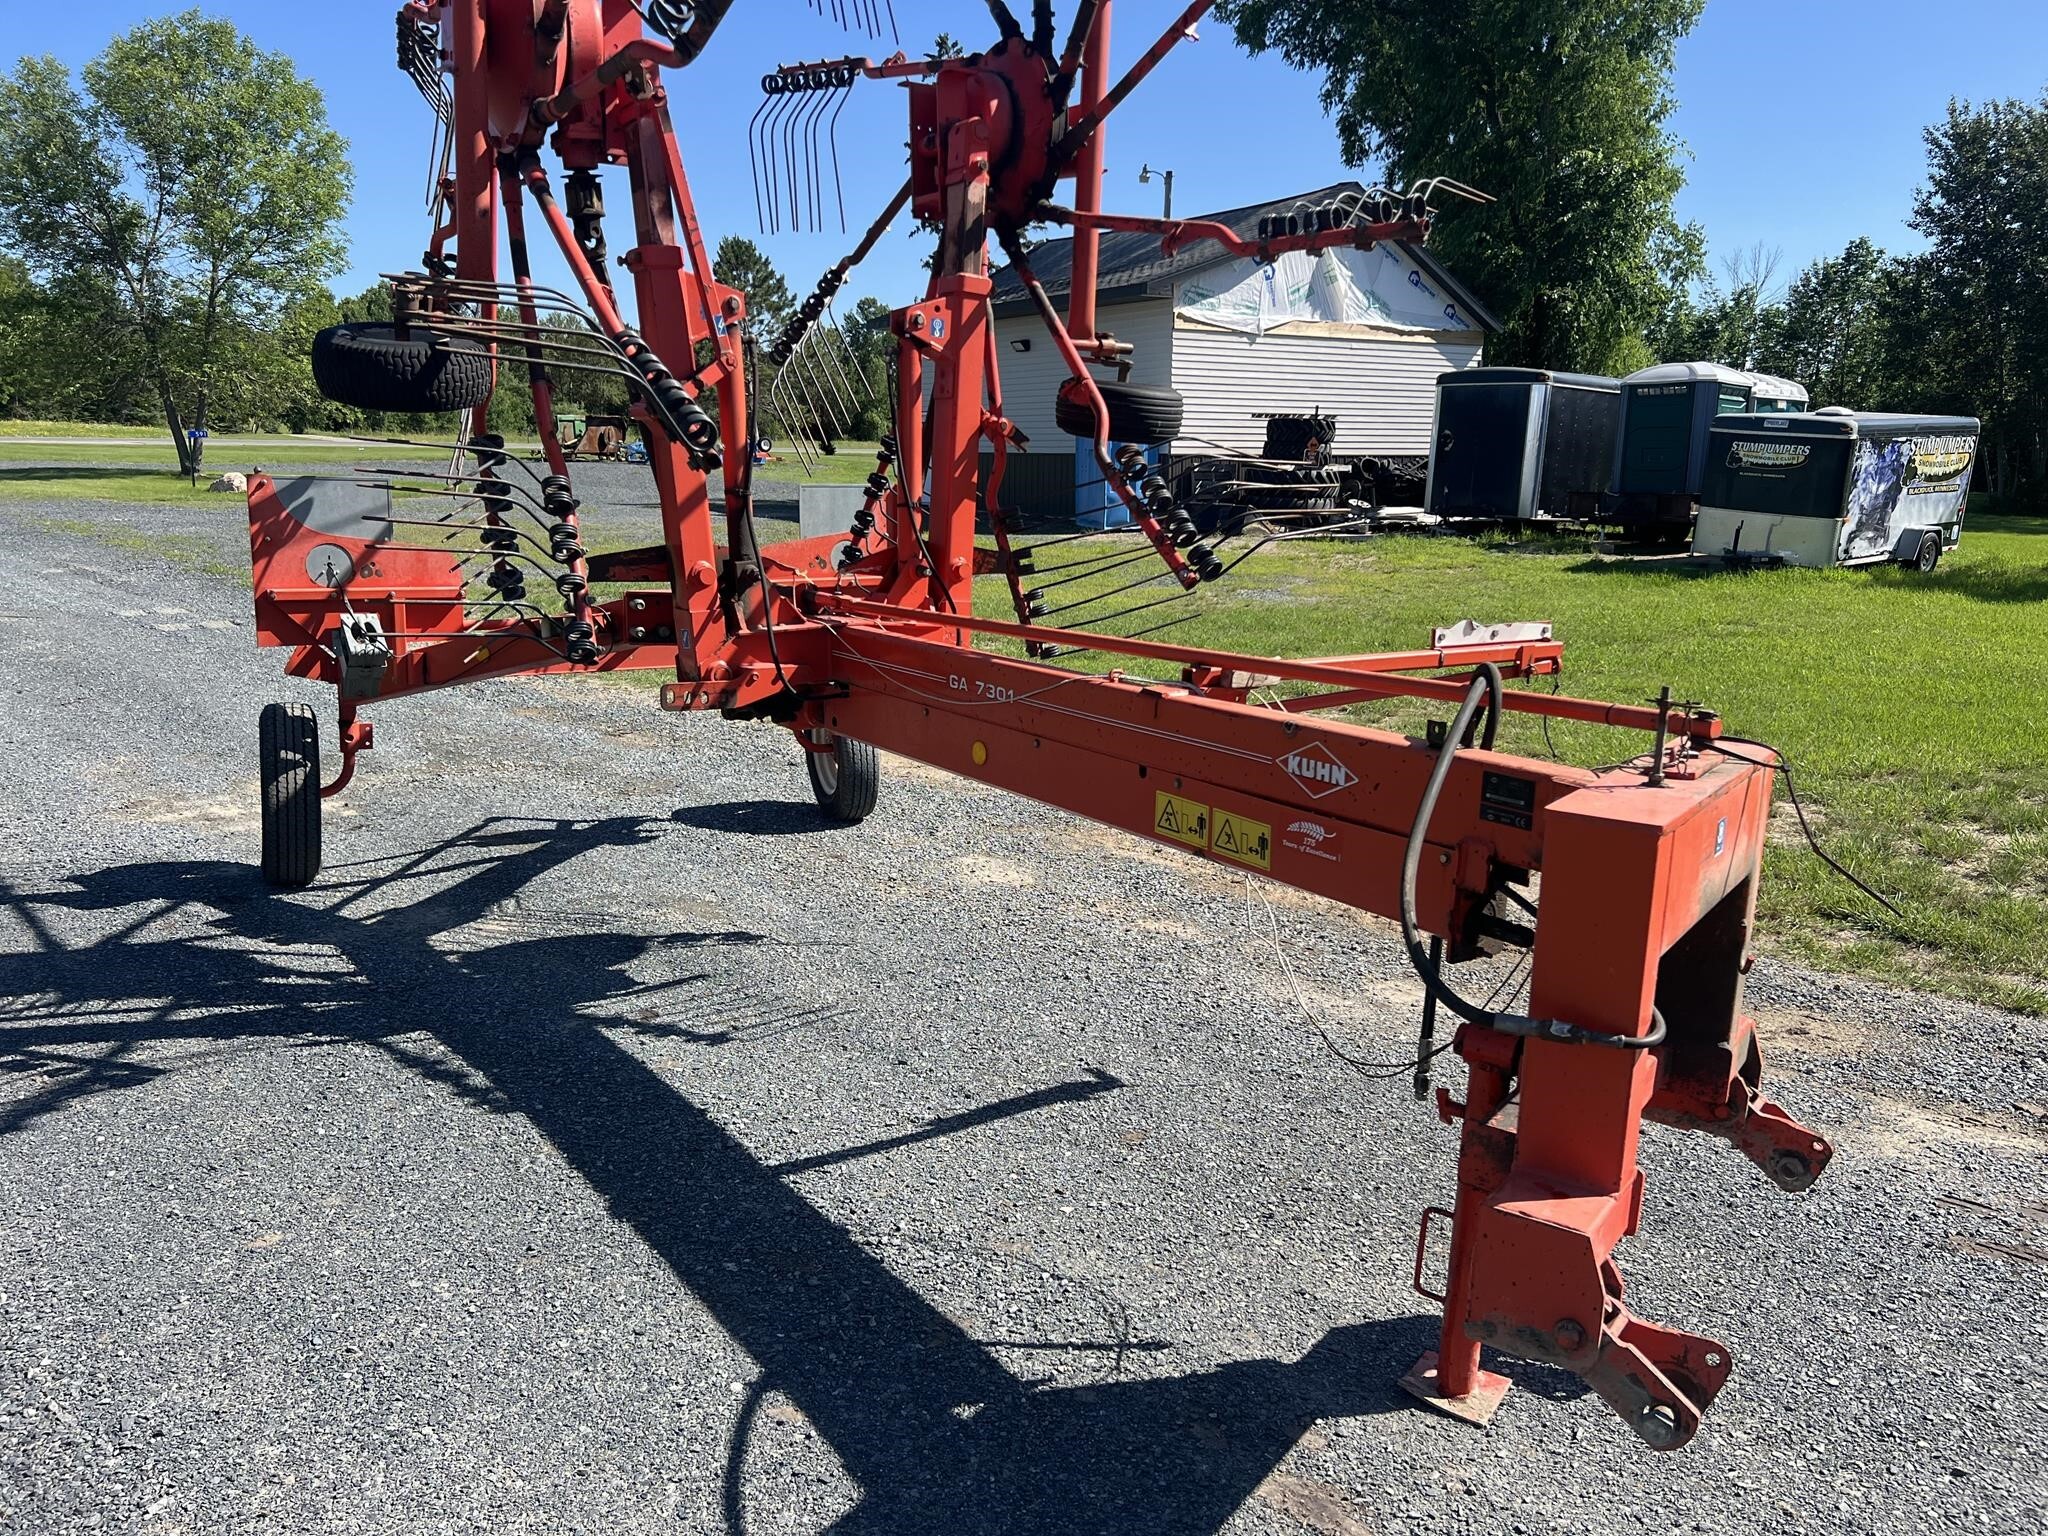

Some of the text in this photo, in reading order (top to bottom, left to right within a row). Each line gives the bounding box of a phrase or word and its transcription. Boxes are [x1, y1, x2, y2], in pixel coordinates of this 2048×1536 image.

[1732, 441, 1811, 455] STUMPJUMPERS
[1911, 435, 1976, 455] STUMPJUMPERS
[1743, 452, 1780, 462] SNOWMOBILE
[949, 674, 1014, 704] GA 7301
[1287, 755, 1346, 786] KUHN
[1303, 837, 1317, 847] 175
